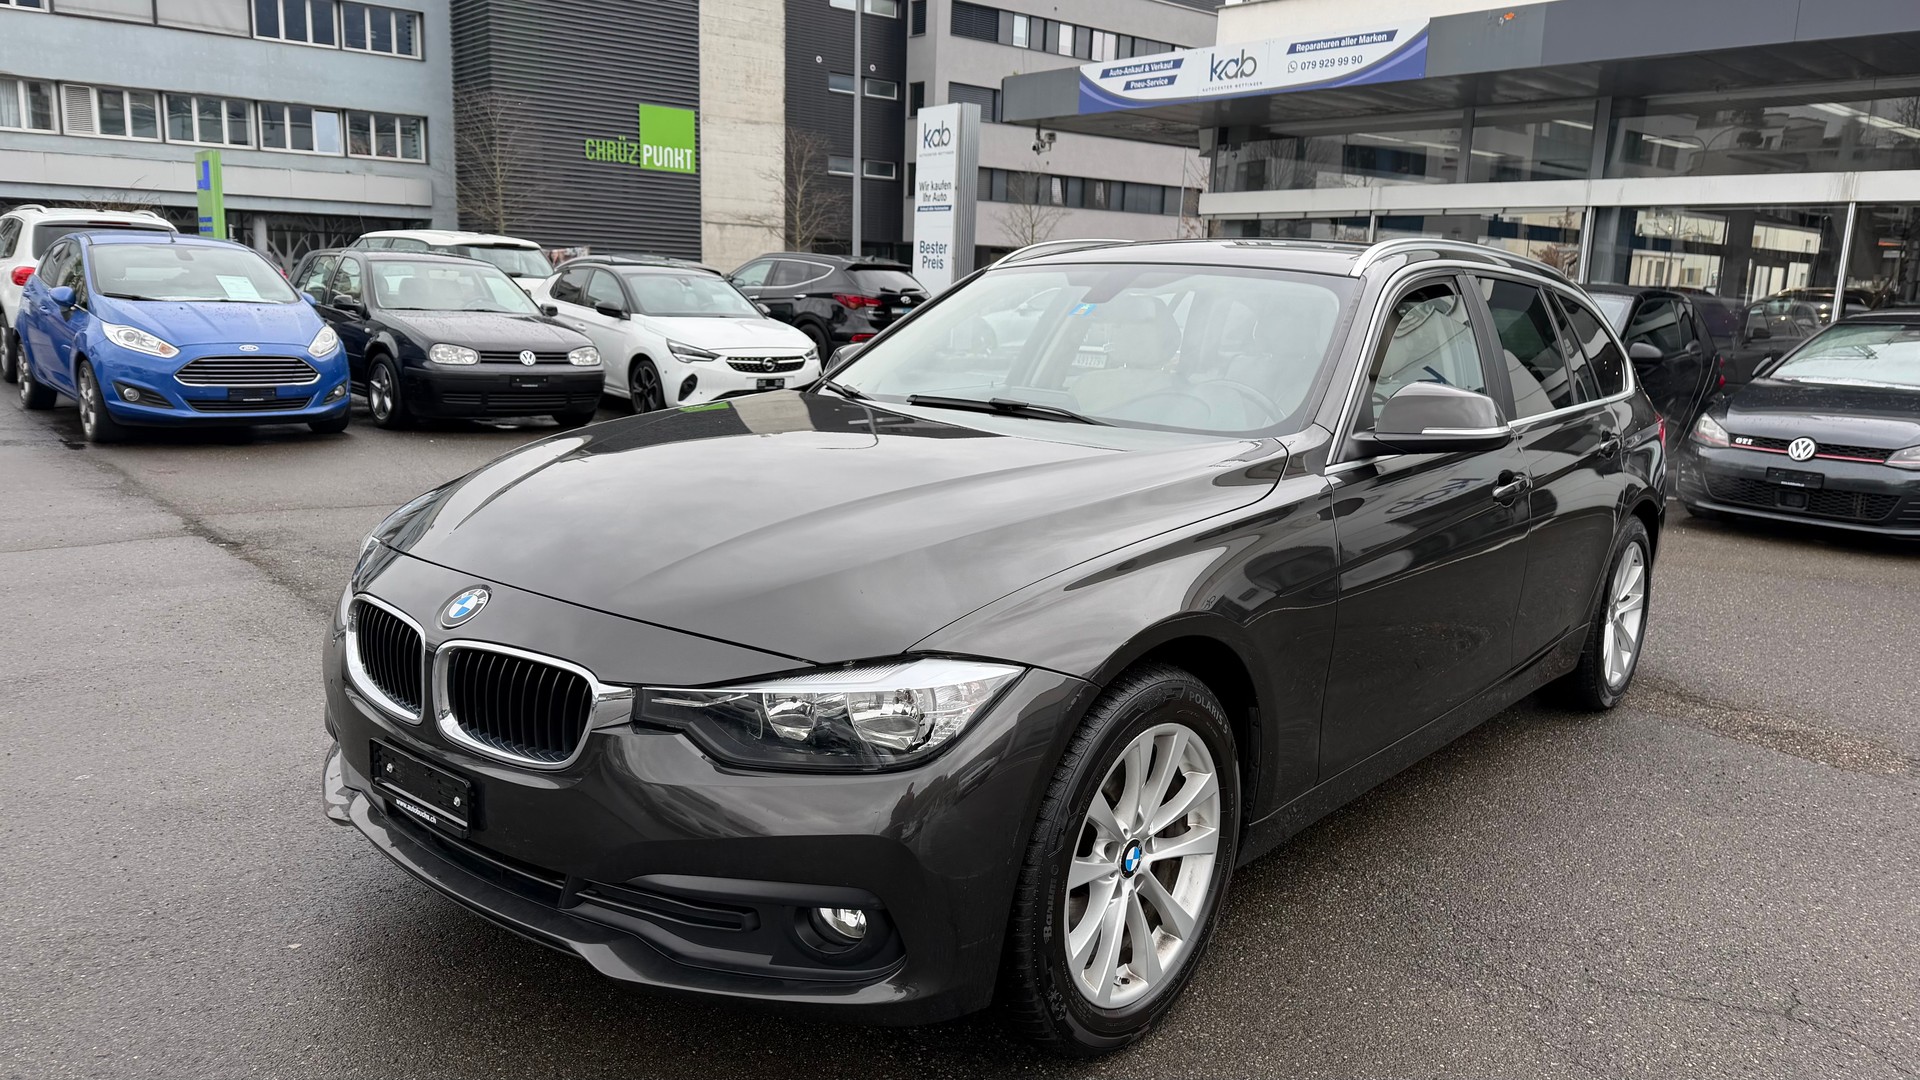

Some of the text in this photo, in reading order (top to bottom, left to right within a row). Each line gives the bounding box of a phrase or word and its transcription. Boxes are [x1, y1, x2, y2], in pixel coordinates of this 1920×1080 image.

[1296, 33, 1387, 52] Reparaturen aller Marken
[1109, 65, 1144, 77] Auto-Ankauf
[1151, 61, 1174, 71] Verkauf
[1210, 49, 1257, 82] kab
[1300, 54, 1363, 70] 079 929 99 90
[1130, 78, 1169, 89] Pneu-Service
[923, 120, 951, 149] kab
[585, 135, 692, 170] CHRÜZ PUNKT
[919, 180, 951, 191] Wir kaufen
[923, 192, 947, 202] Ihr Auto
[920, 240, 947, 254] Bester
[922, 255, 944, 269] Preis
[1735, 437, 1753, 445] GTI
[1189, 691, 1223, 725] POLARIS
